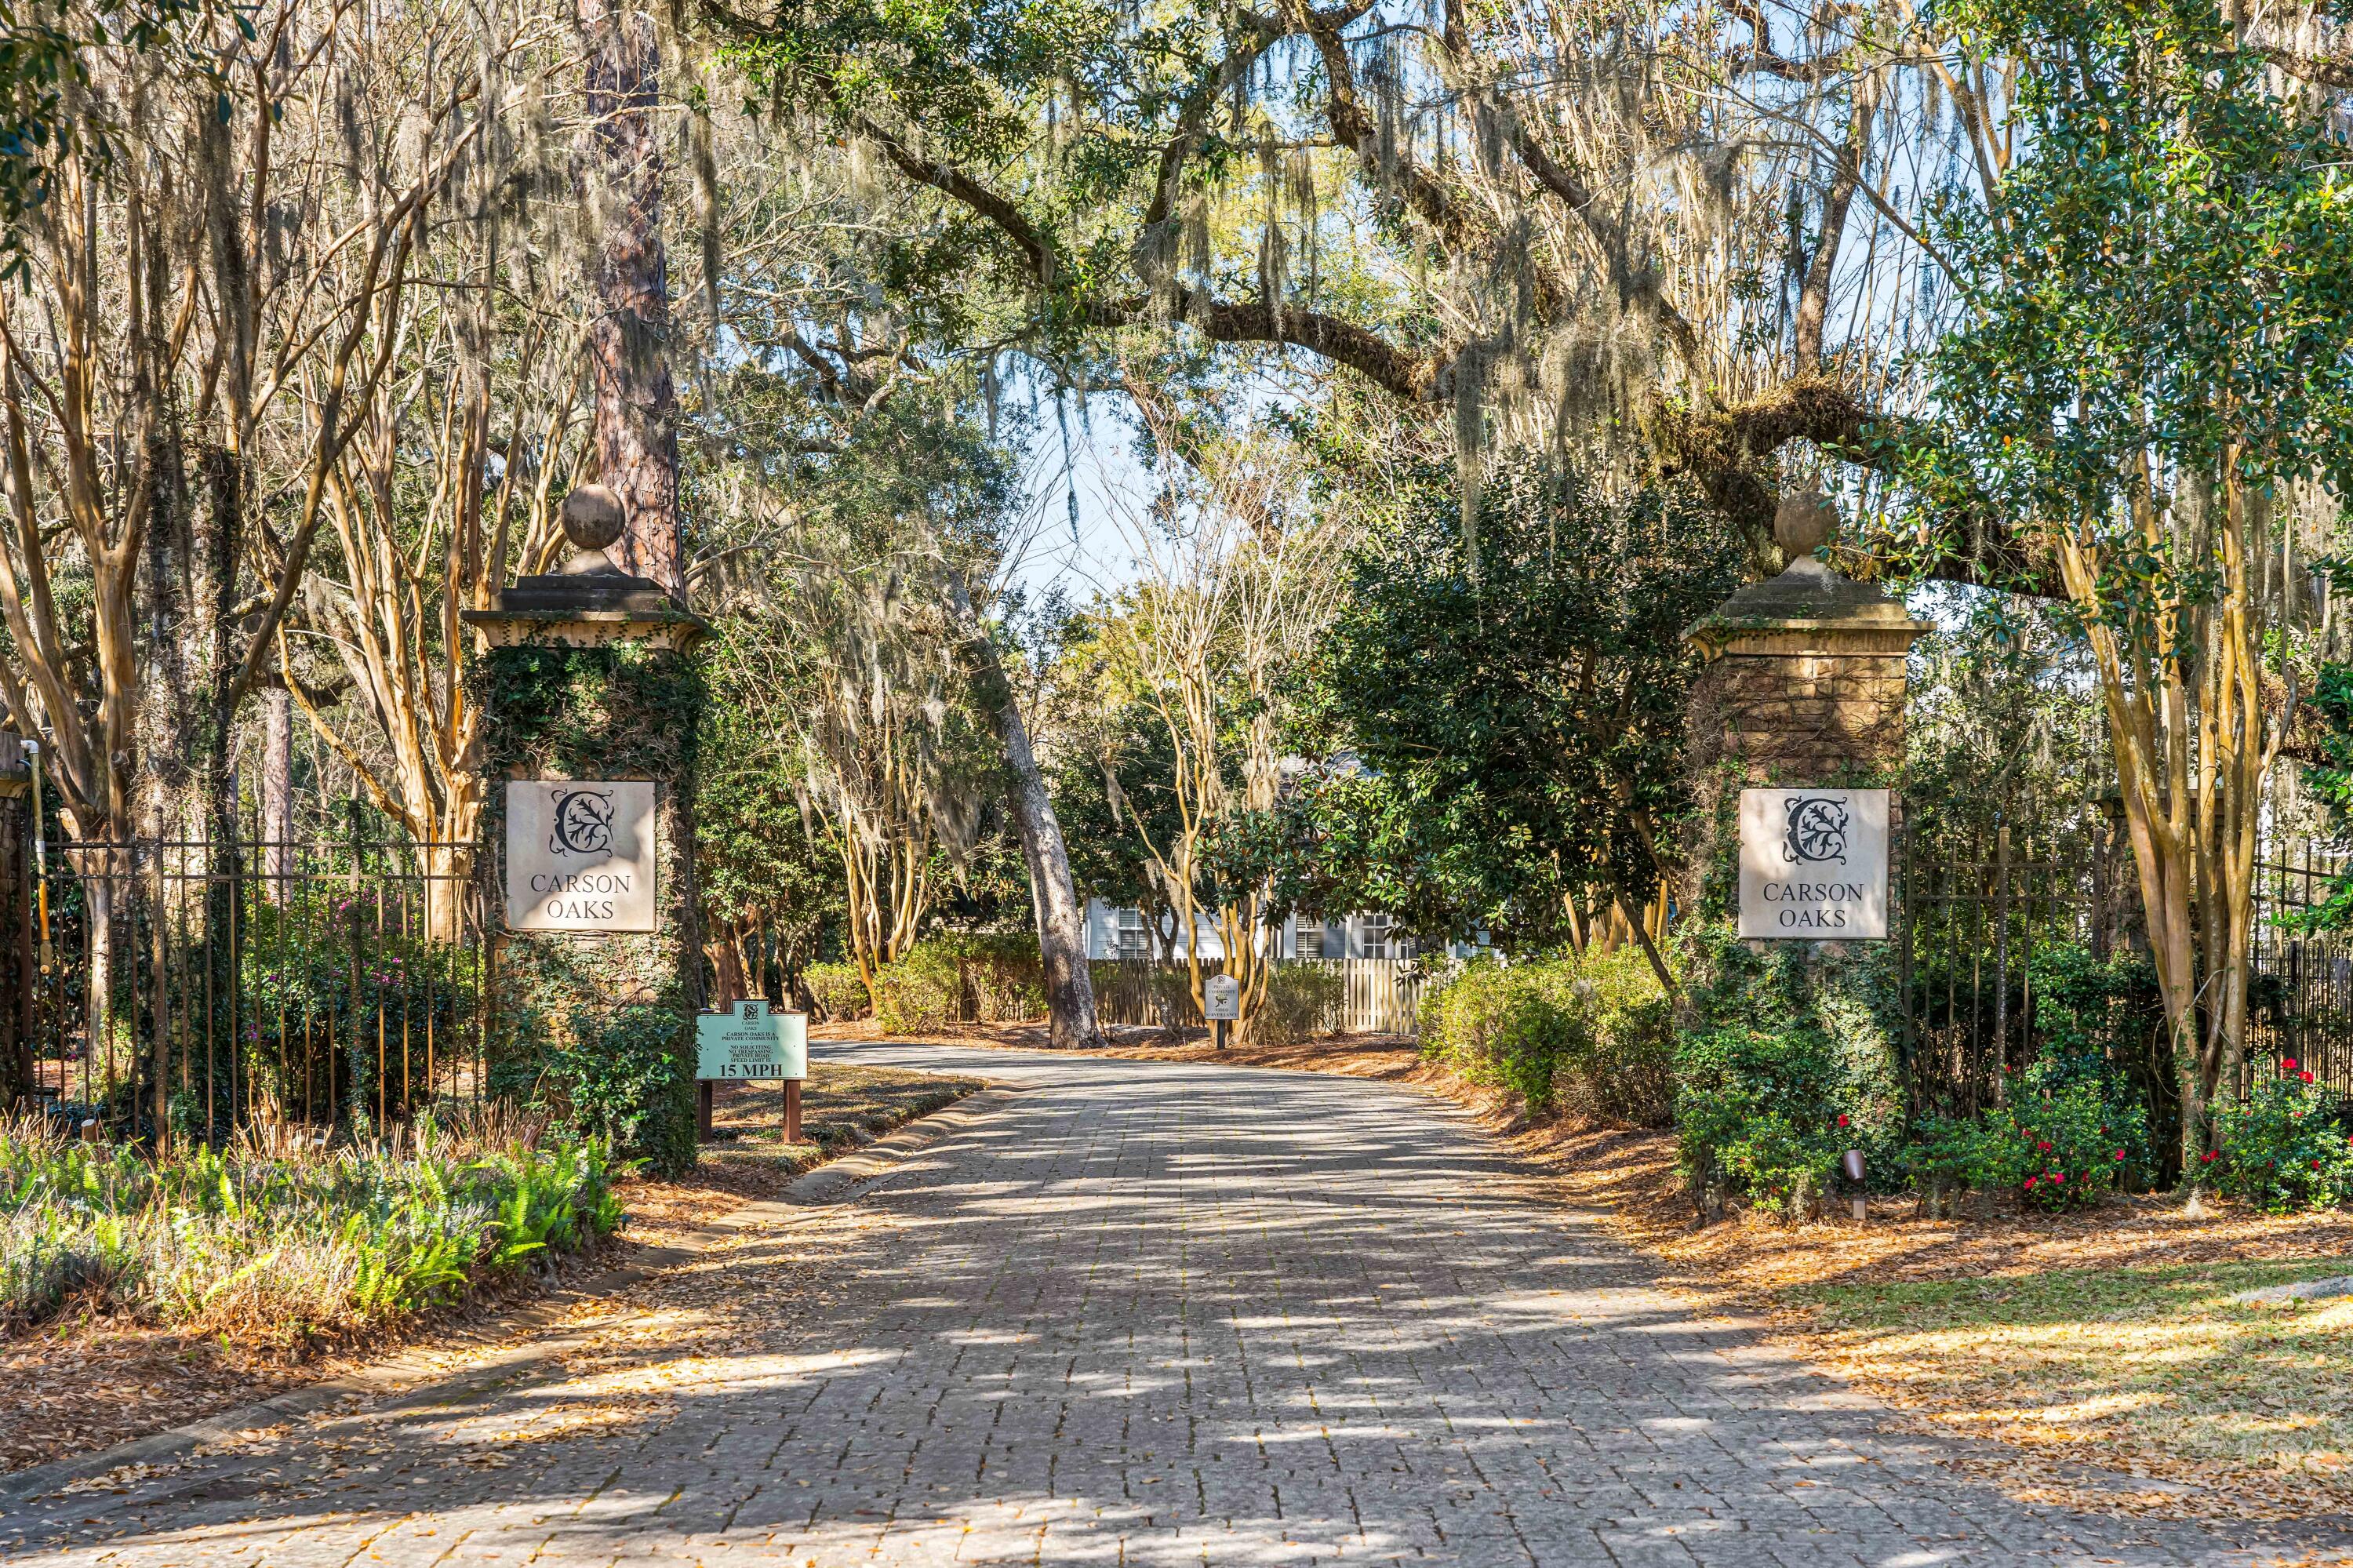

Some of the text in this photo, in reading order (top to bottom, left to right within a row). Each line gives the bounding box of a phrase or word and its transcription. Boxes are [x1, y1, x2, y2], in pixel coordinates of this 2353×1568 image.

[530, 874, 631, 893] CARSON
[1763, 882, 1864, 902] CARSON
[547, 900, 614, 919] OAKS
[1779, 908, 1846, 928] OAKS
[720, 1064, 783, 1076] 15 MPH
